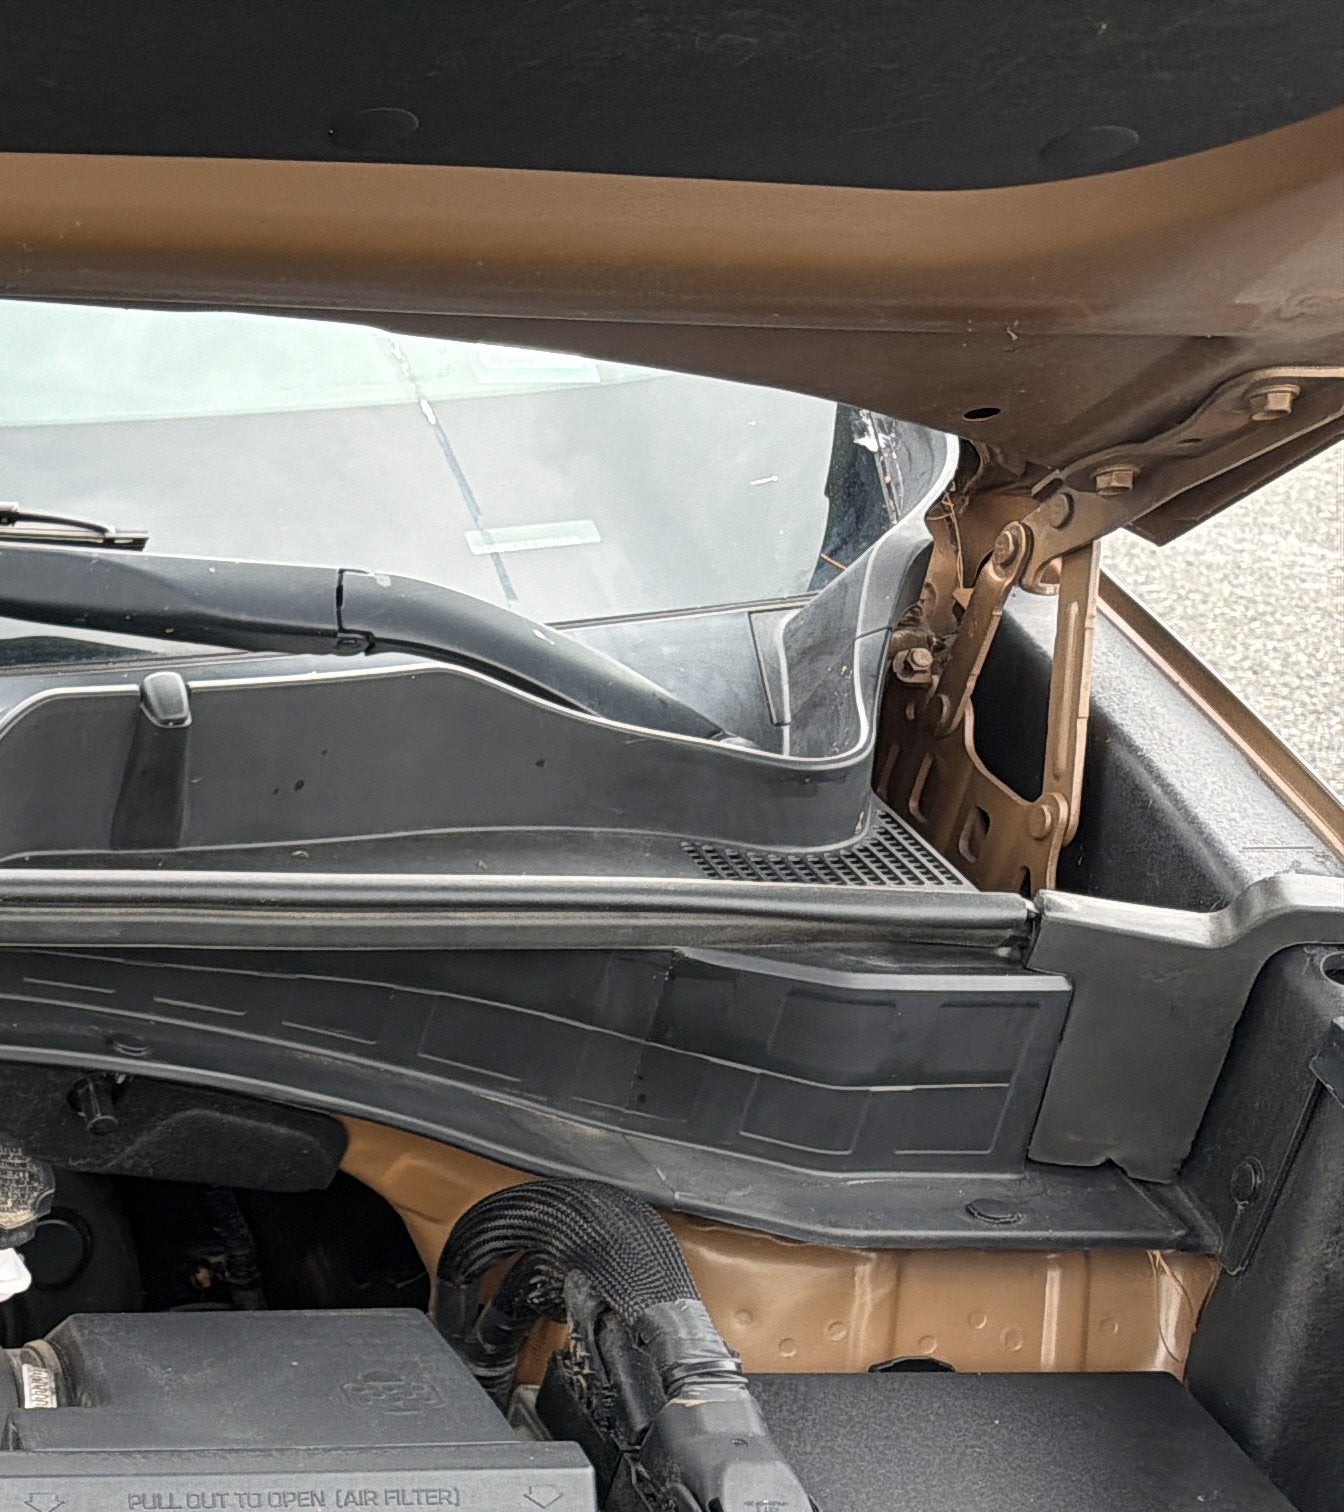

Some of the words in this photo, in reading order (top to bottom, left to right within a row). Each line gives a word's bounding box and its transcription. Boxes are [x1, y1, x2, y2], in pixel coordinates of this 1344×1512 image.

[127, 1492, 183, 1510] PULL
[186, 1491, 229, 1509] OUT
[233, 1491, 262, 1508] TO
[267, 1489, 326, 1508] OPEN
